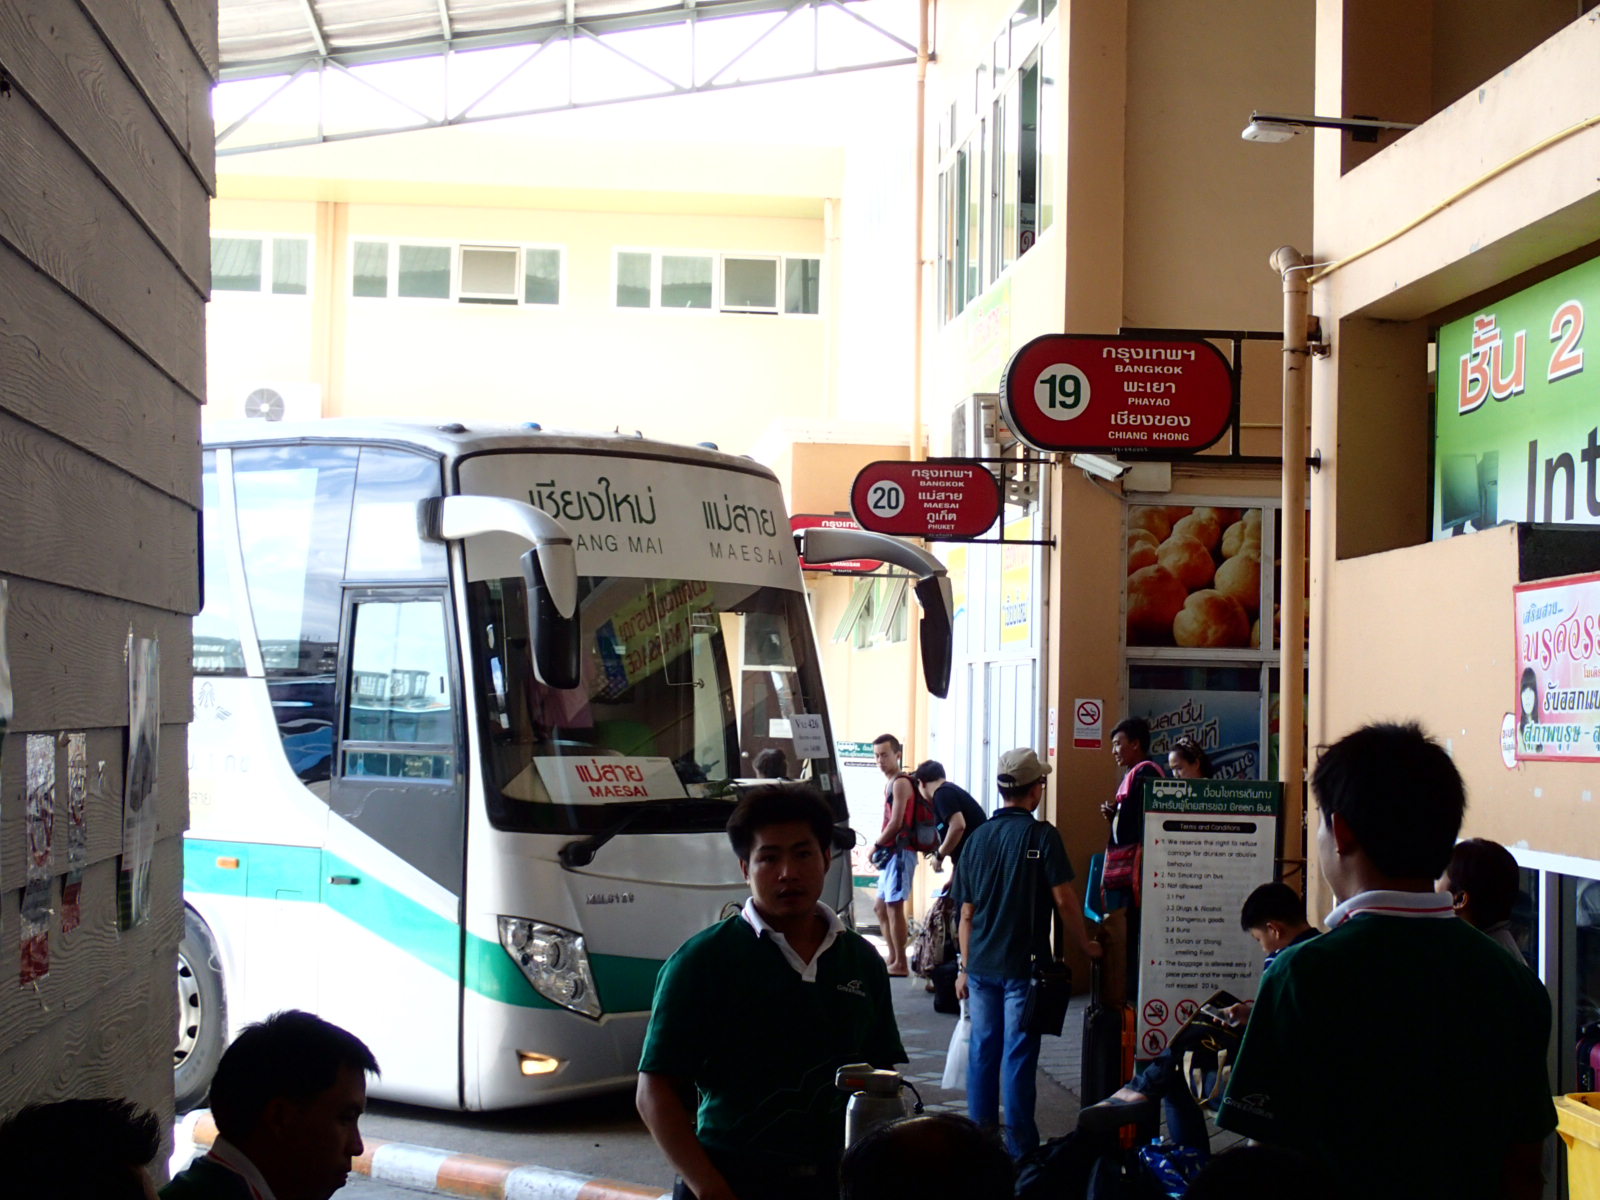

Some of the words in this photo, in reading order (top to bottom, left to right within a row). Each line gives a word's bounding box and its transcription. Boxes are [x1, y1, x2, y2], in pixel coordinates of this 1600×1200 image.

[1103, 347, 1195, 362] กรุงเทพฯ
[1459, 314, 1526, 415] ชั้น
[1548, 299, 1584, 383] 2
[1115, 365, 1182, 374] BANGKOK
[1040, 374, 1081, 409] 19
[1124, 380, 1176, 394] พะเยา
[1128, 397, 1170, 406] PHAYAO
[1111, 411, 1190, 427] เชียงของ
[1108, 431, 1148, 441] CHIANG
[1153, 432, 1189, 441] KHONG
[912, 469, 972, 480] กรุงเทพฯ
[873, 487, 900, 509] 20
[918, 490, 962, 500] แม่สาย
[702, 494, 777, 537] แม่สาย
[926, 510, 956, 522] ภูเก็ต
[629, 535, 663, 554] MAI
[710, 542, 783, 566] MAESAI
[577, 759, 644, 783] แม่สาย
[589, 786, 648, 798] MAESAI
[1229, 803, 1254, 812] Green
[1256, 803, 1272, 812] Bus
[1198, 823, 1210, 831] and
[1211, 823, 1241, 831] Conditions
[1178, 872, 1202, 880] Smoking
[1203, 938, 1222, 946] Strong
[1177, 960, 1203, 968] baggage
